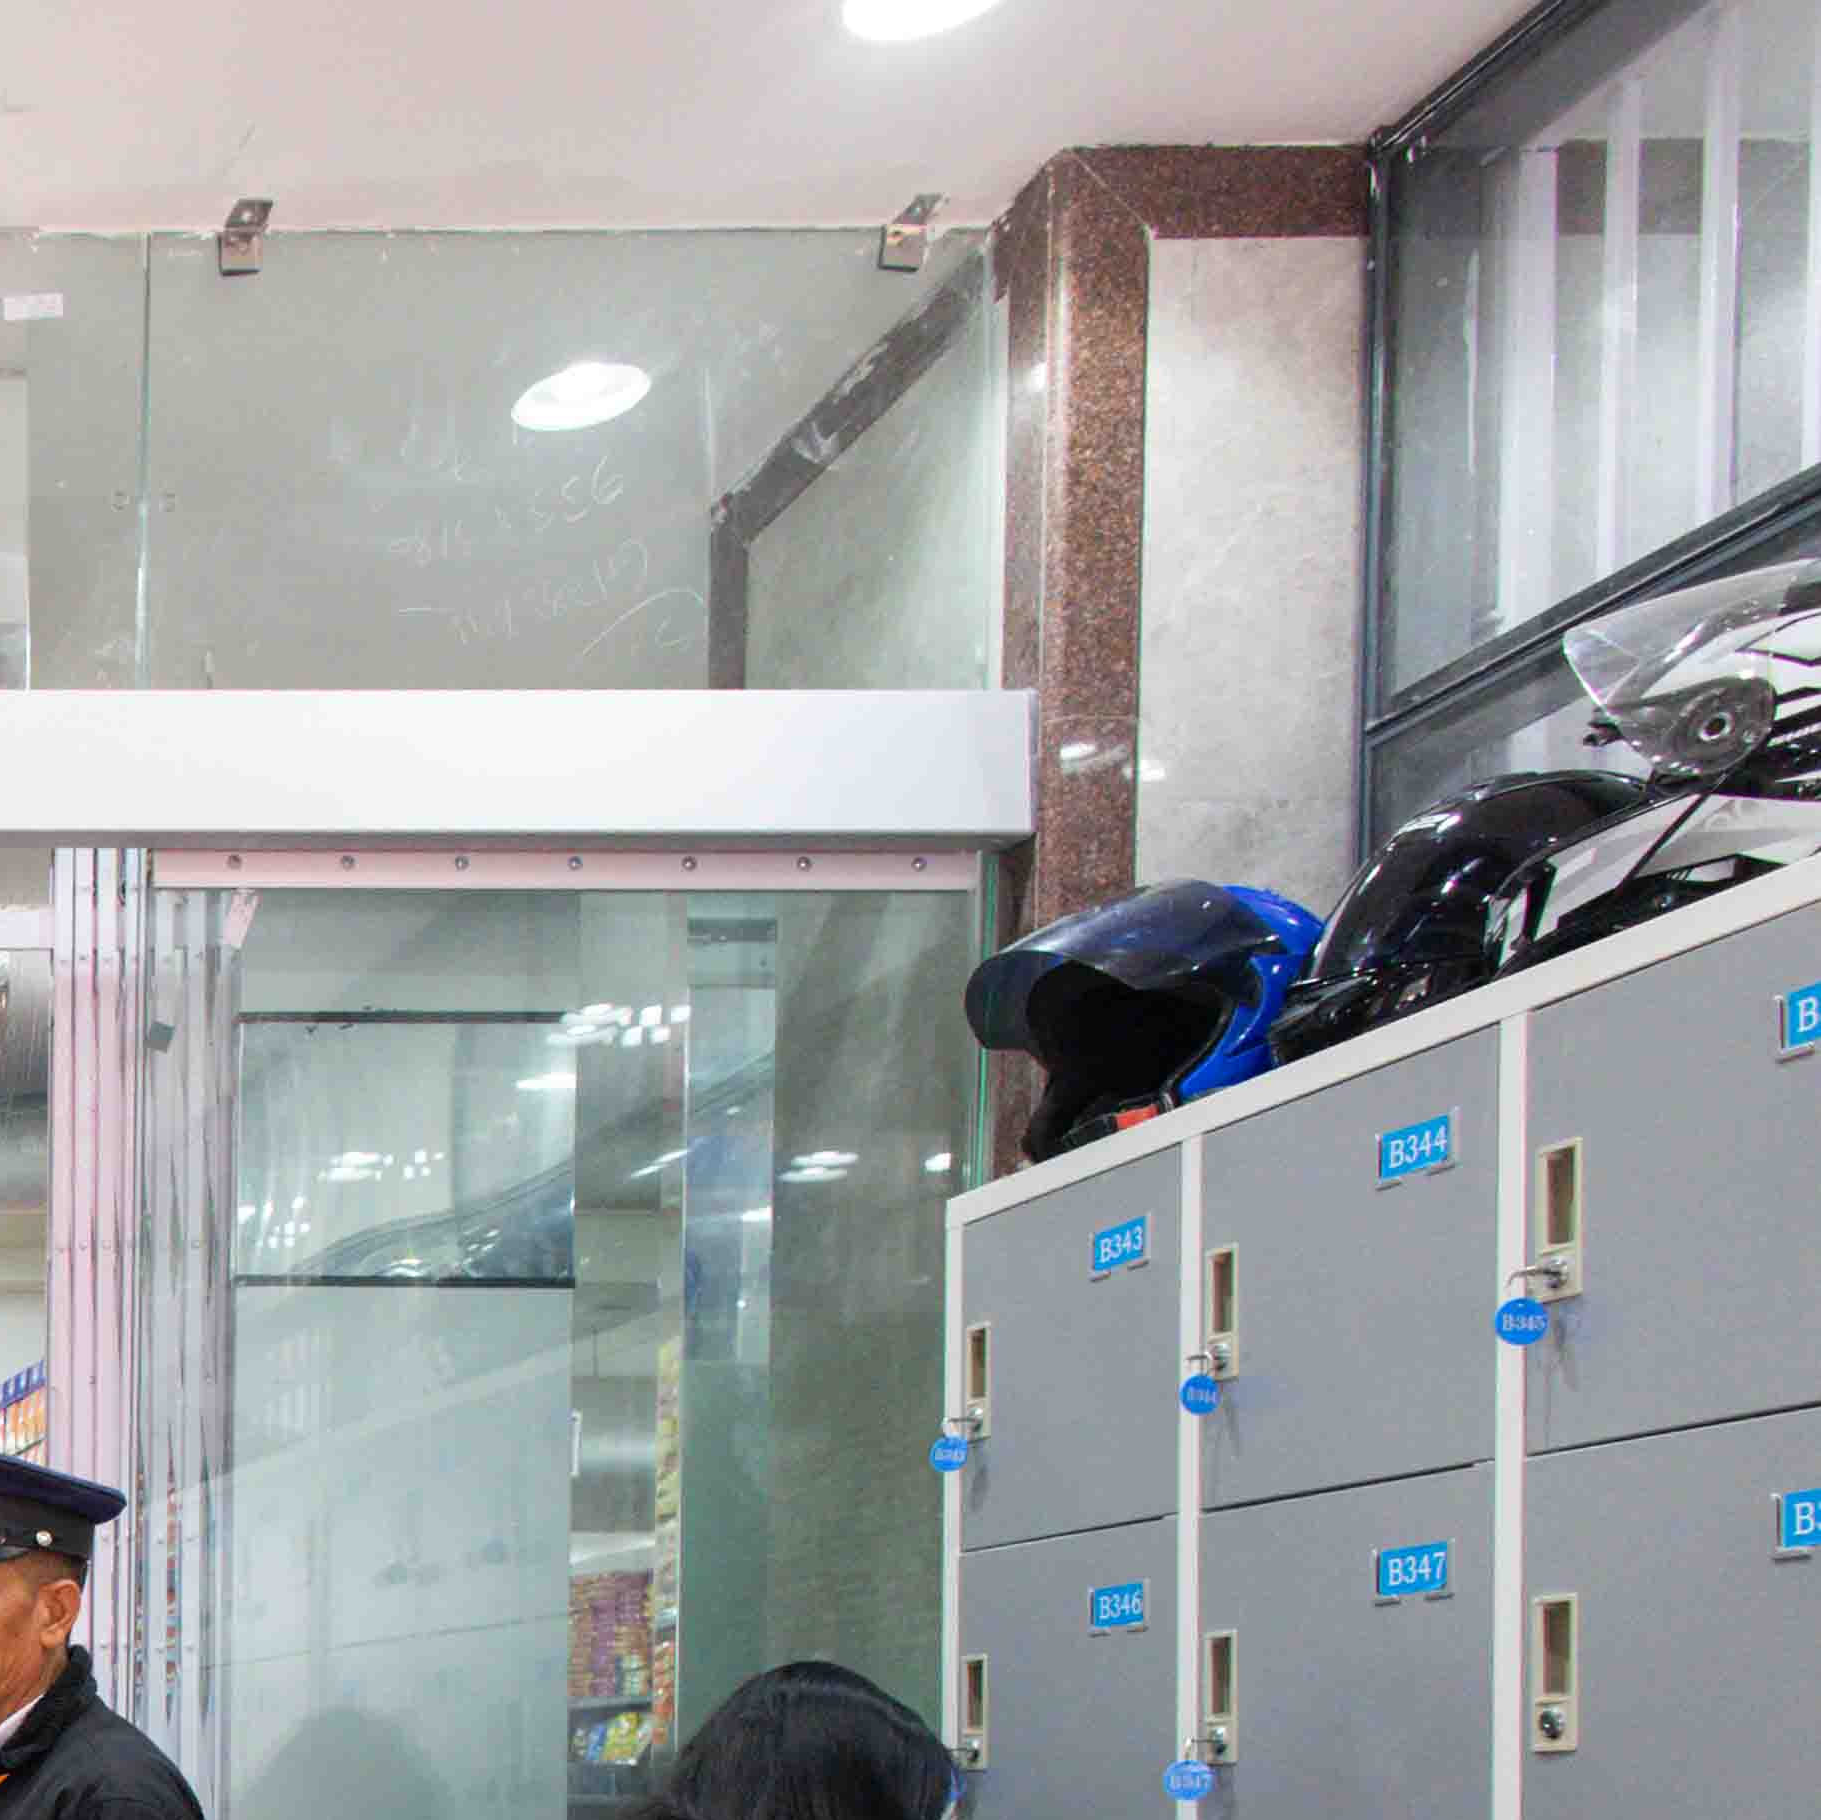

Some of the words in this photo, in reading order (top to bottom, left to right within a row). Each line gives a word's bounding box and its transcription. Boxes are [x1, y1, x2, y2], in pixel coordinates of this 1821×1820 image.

[1388, 1125, 1448, 1171] B344
[1100, 1224, 1143, 1263] B343
[1386, 1551, 1446, 1588] B347
[1098, 1589, 1144, 1622] B346
